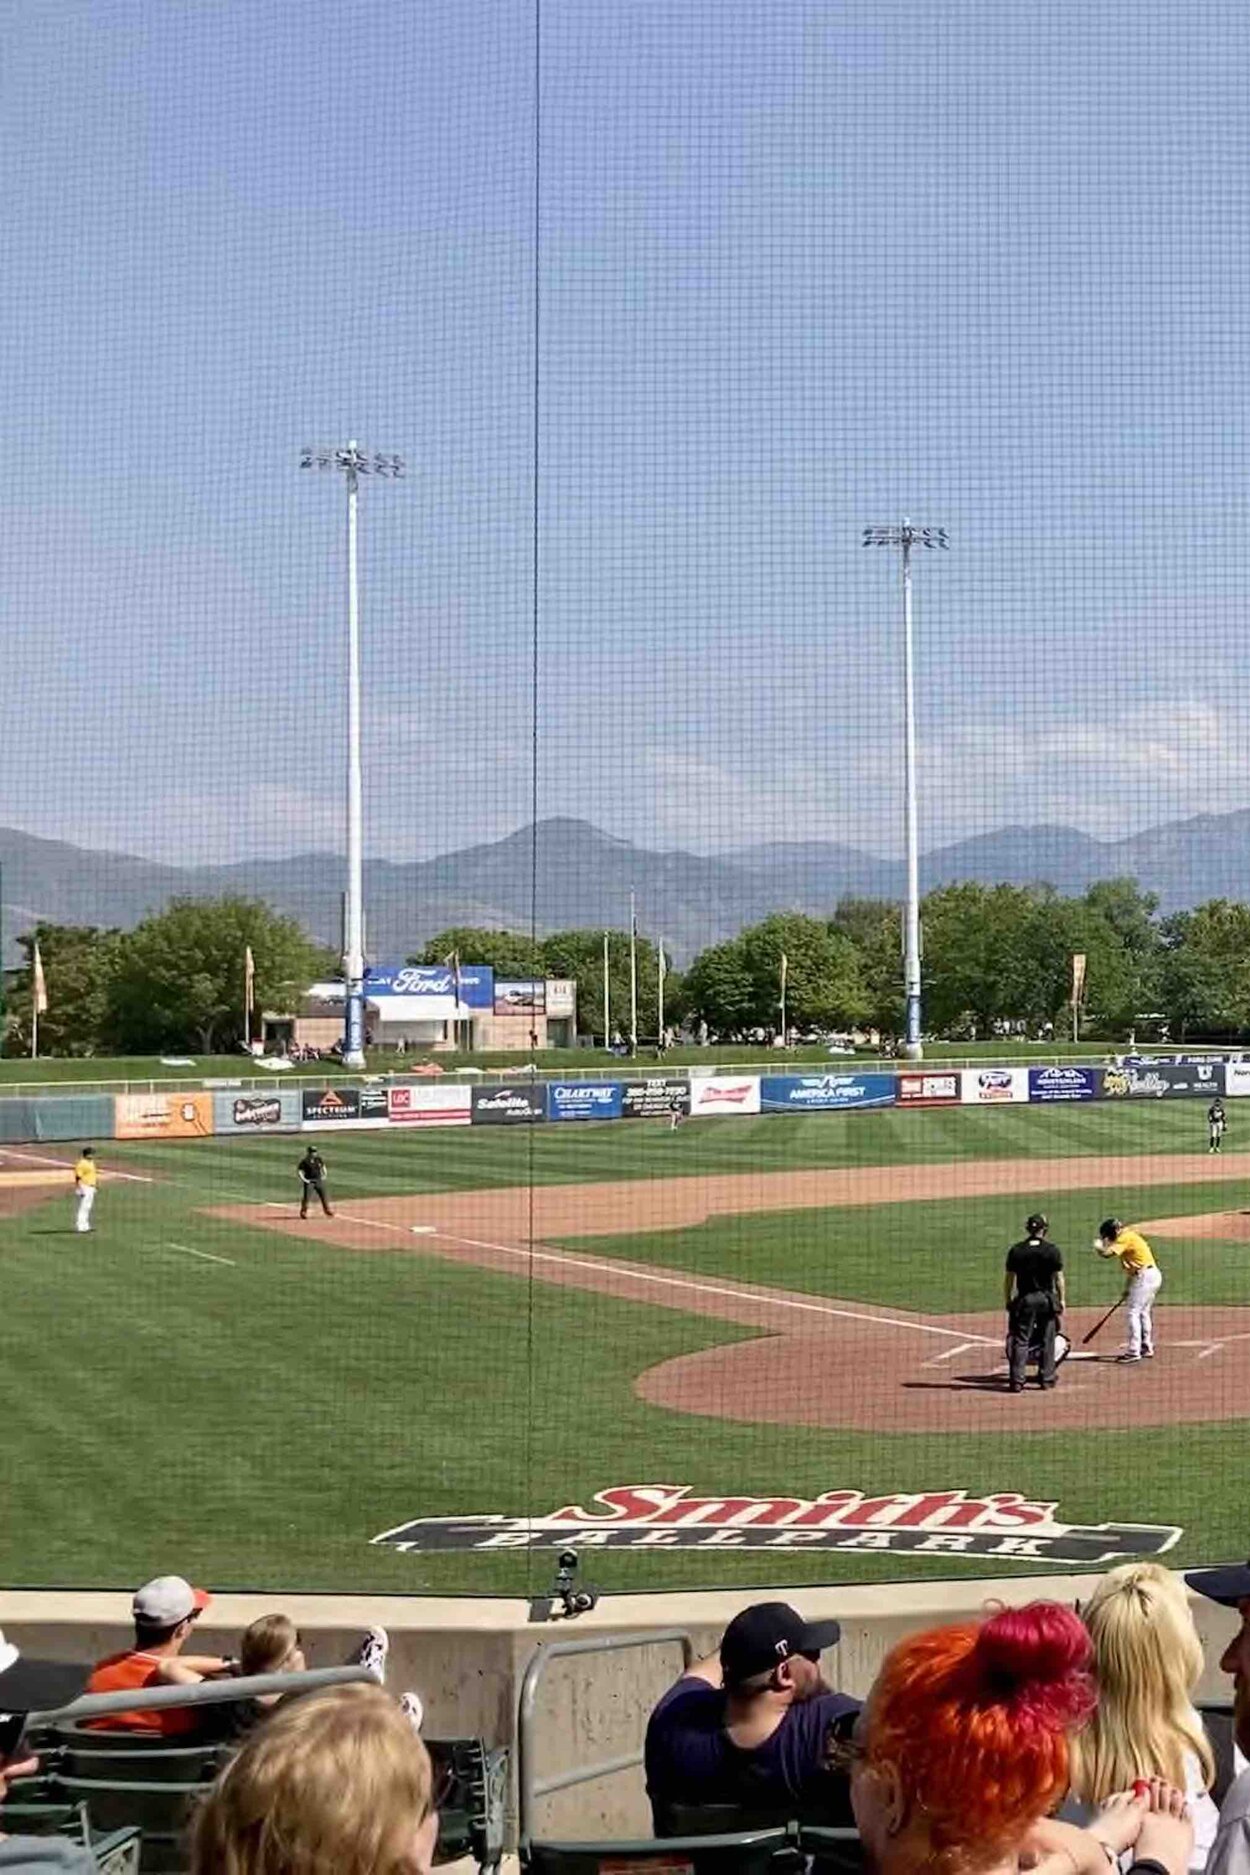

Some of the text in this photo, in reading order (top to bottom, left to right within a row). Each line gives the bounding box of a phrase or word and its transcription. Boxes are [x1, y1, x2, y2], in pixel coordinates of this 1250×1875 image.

[392, 967, 451, 993] Ford
[306, 1105, 357, 1115] SPECTRUM
[550, 1489, 1050, 1528] Smith's
[473, 1529, 1054, 1555] BALLPARK
